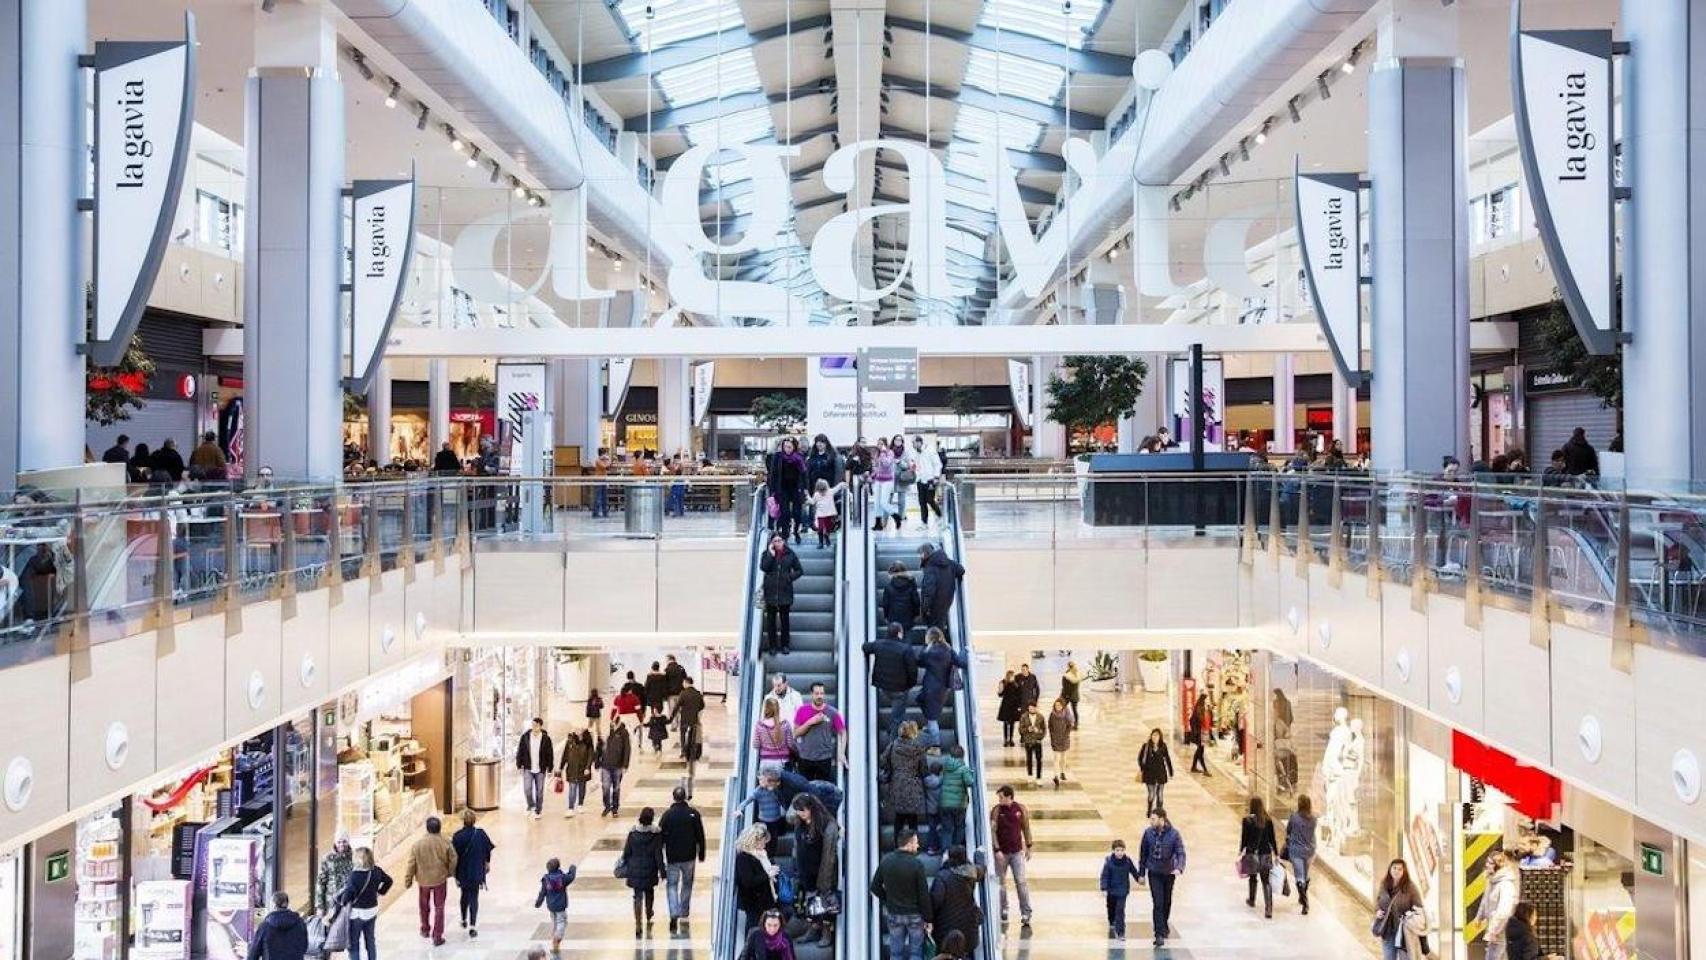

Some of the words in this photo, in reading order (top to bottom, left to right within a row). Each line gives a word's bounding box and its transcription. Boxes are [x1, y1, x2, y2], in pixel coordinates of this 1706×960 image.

[117, 79, 152, 158] gavia
[1559, 71, 1595, 152] gavia
[116, 162, 144, 189] la
[1558, 155, 1586, 183] la
[366, 204, 390, 257] gavia
[1323, 196, 1346, 249] gavia
[366, 260, 385, 278] la
[1323, 252, 1342, 270] la
